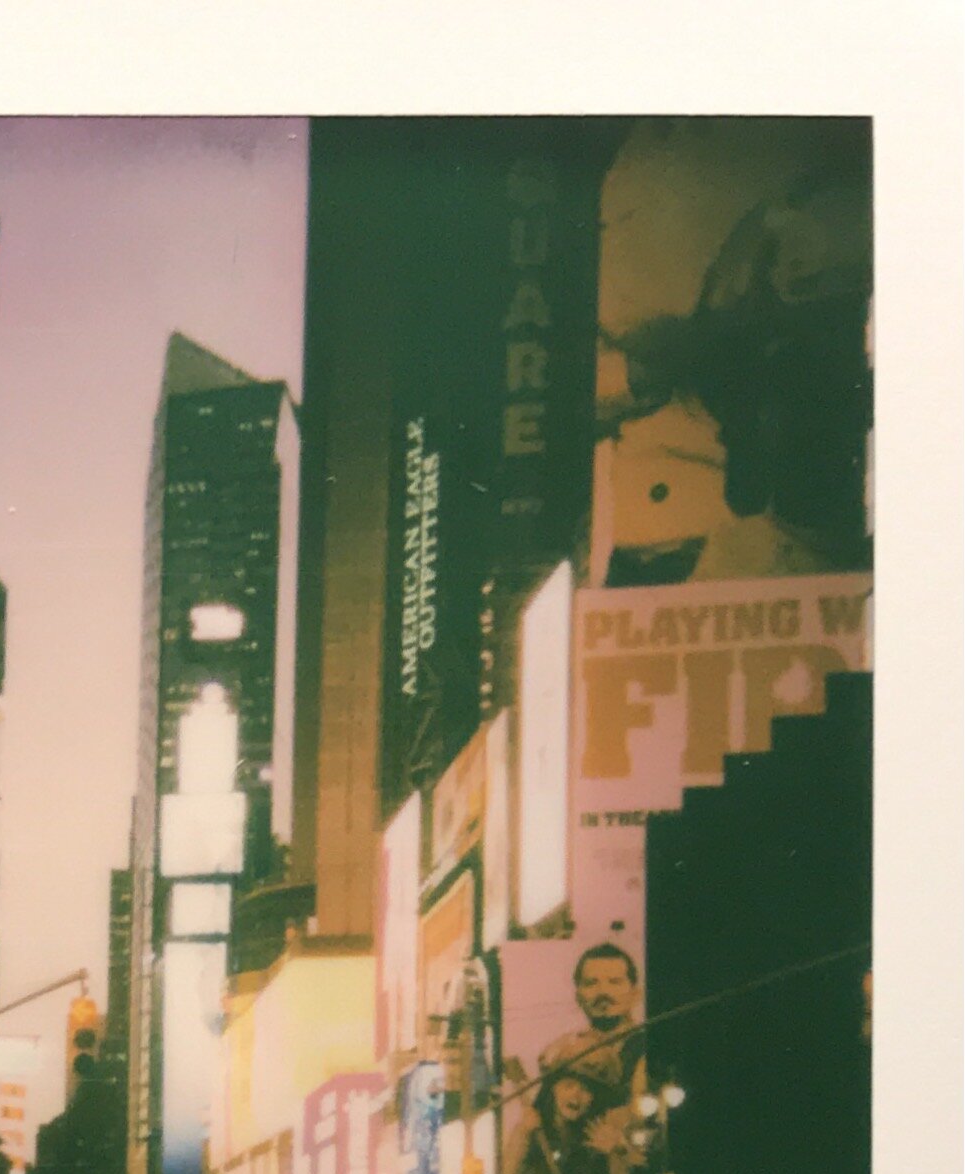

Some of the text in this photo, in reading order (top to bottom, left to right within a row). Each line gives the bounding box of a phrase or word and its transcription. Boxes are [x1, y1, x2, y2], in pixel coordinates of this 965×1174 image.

[401, 417, 424, 695] AMERICAN EAGLE
[419, 452, 440, 649] OUTFITTERS
[583, 599, 801, 650] PLAYING
